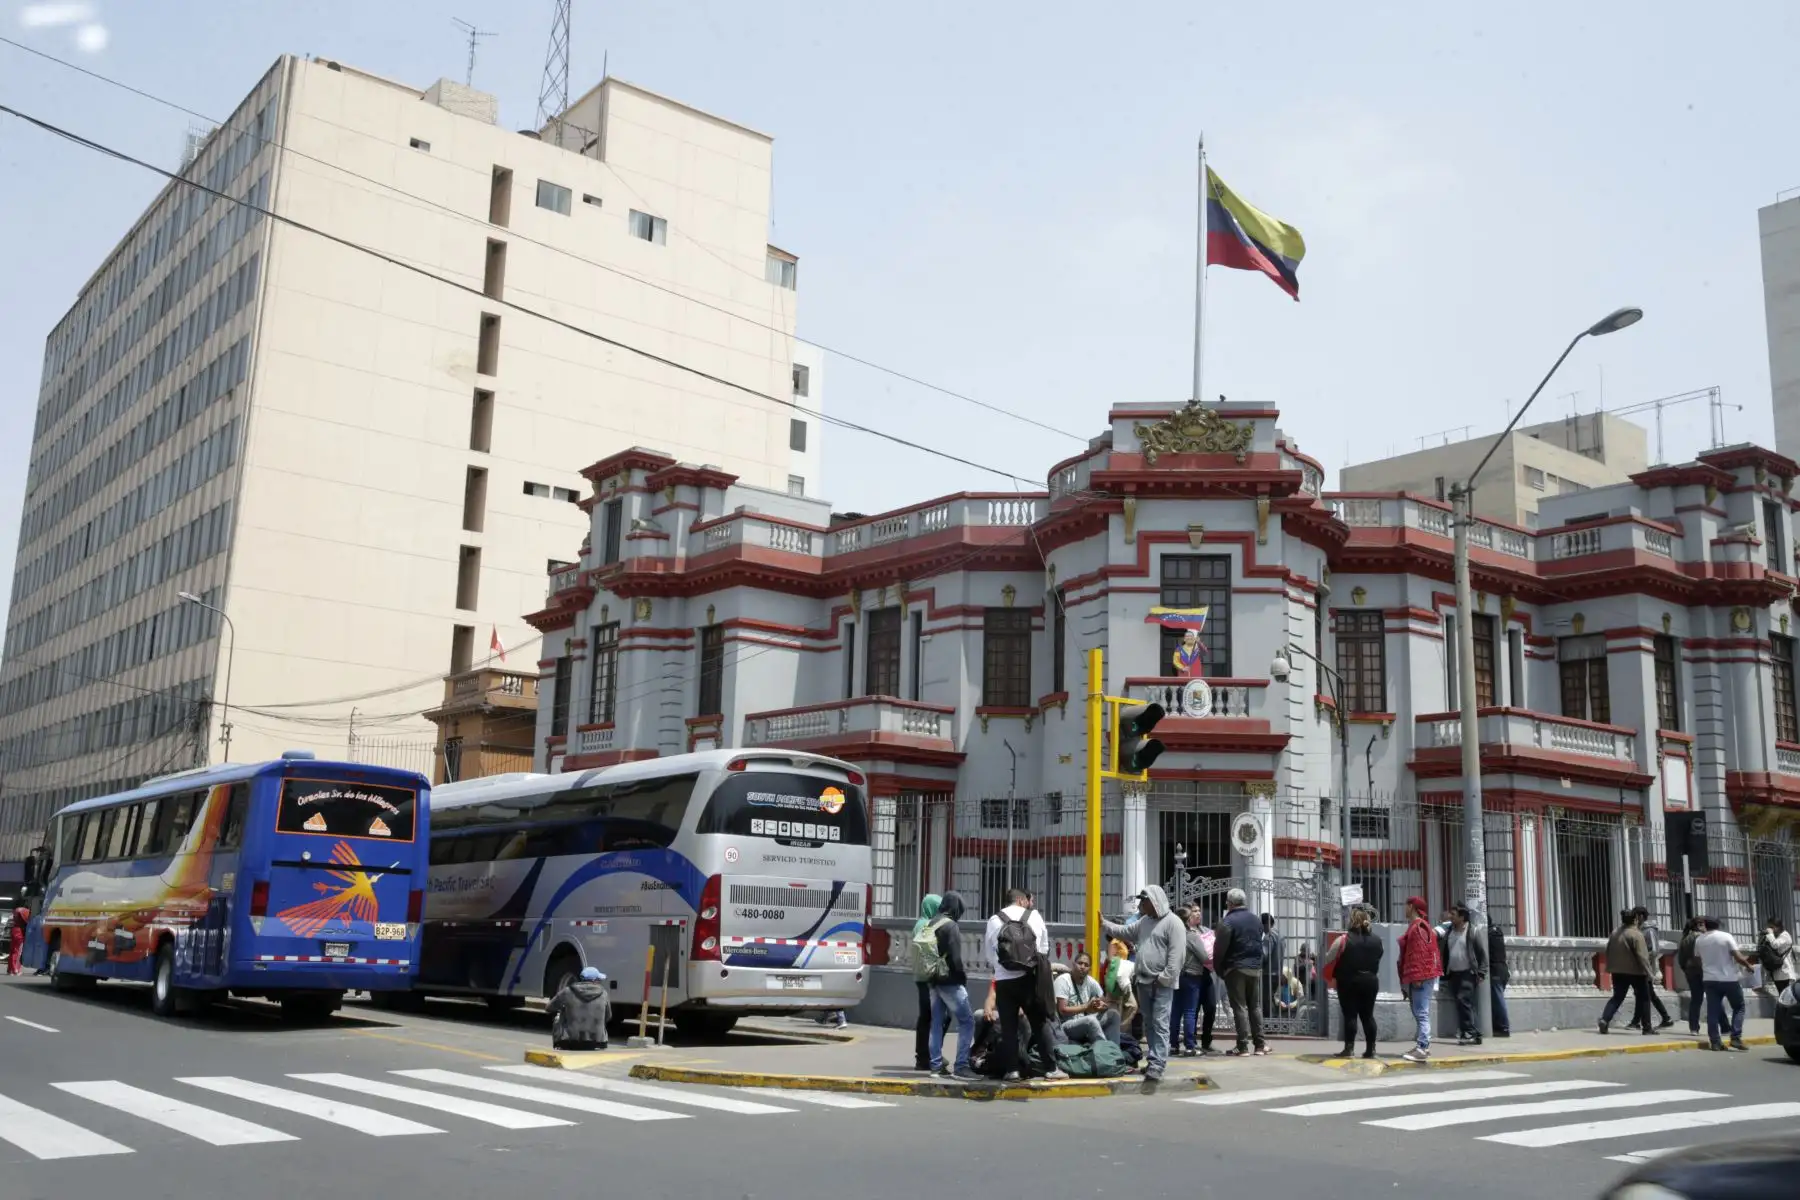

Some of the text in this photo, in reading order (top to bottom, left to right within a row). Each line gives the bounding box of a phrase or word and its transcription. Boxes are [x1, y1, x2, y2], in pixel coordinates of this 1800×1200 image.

[746, 791, 776, 803] SOUTH
[776, 794, 806, 806] PACIFIC
[727, 851, 737, 860] 90
[762, 854, 797, 864] SERVICIO
[741, 908, 785, 920] 480-0080
[375, 927, 405, 937] B2P-968
[725, 946, 768, 955] Mercedes-Benz
